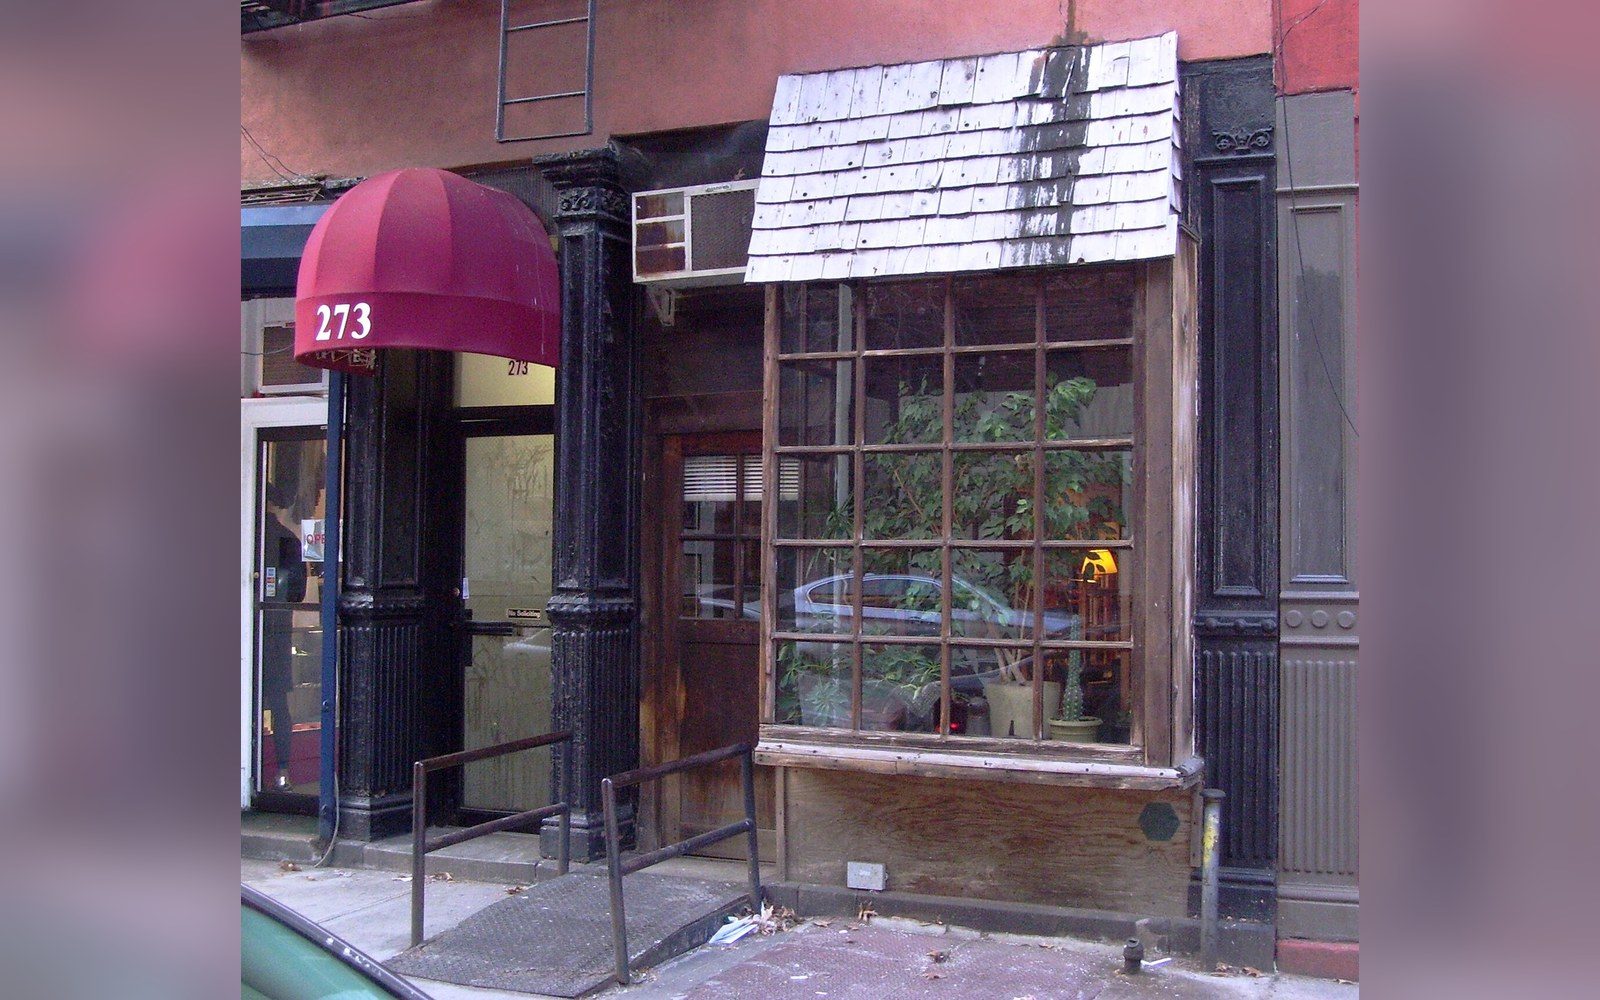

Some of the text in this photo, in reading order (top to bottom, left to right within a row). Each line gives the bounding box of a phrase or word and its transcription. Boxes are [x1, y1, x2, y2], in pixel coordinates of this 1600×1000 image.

[315, 302, 372, 341] 273
[508, 360, 528, 376] 273
[306, 533, 326, 545] OPE
